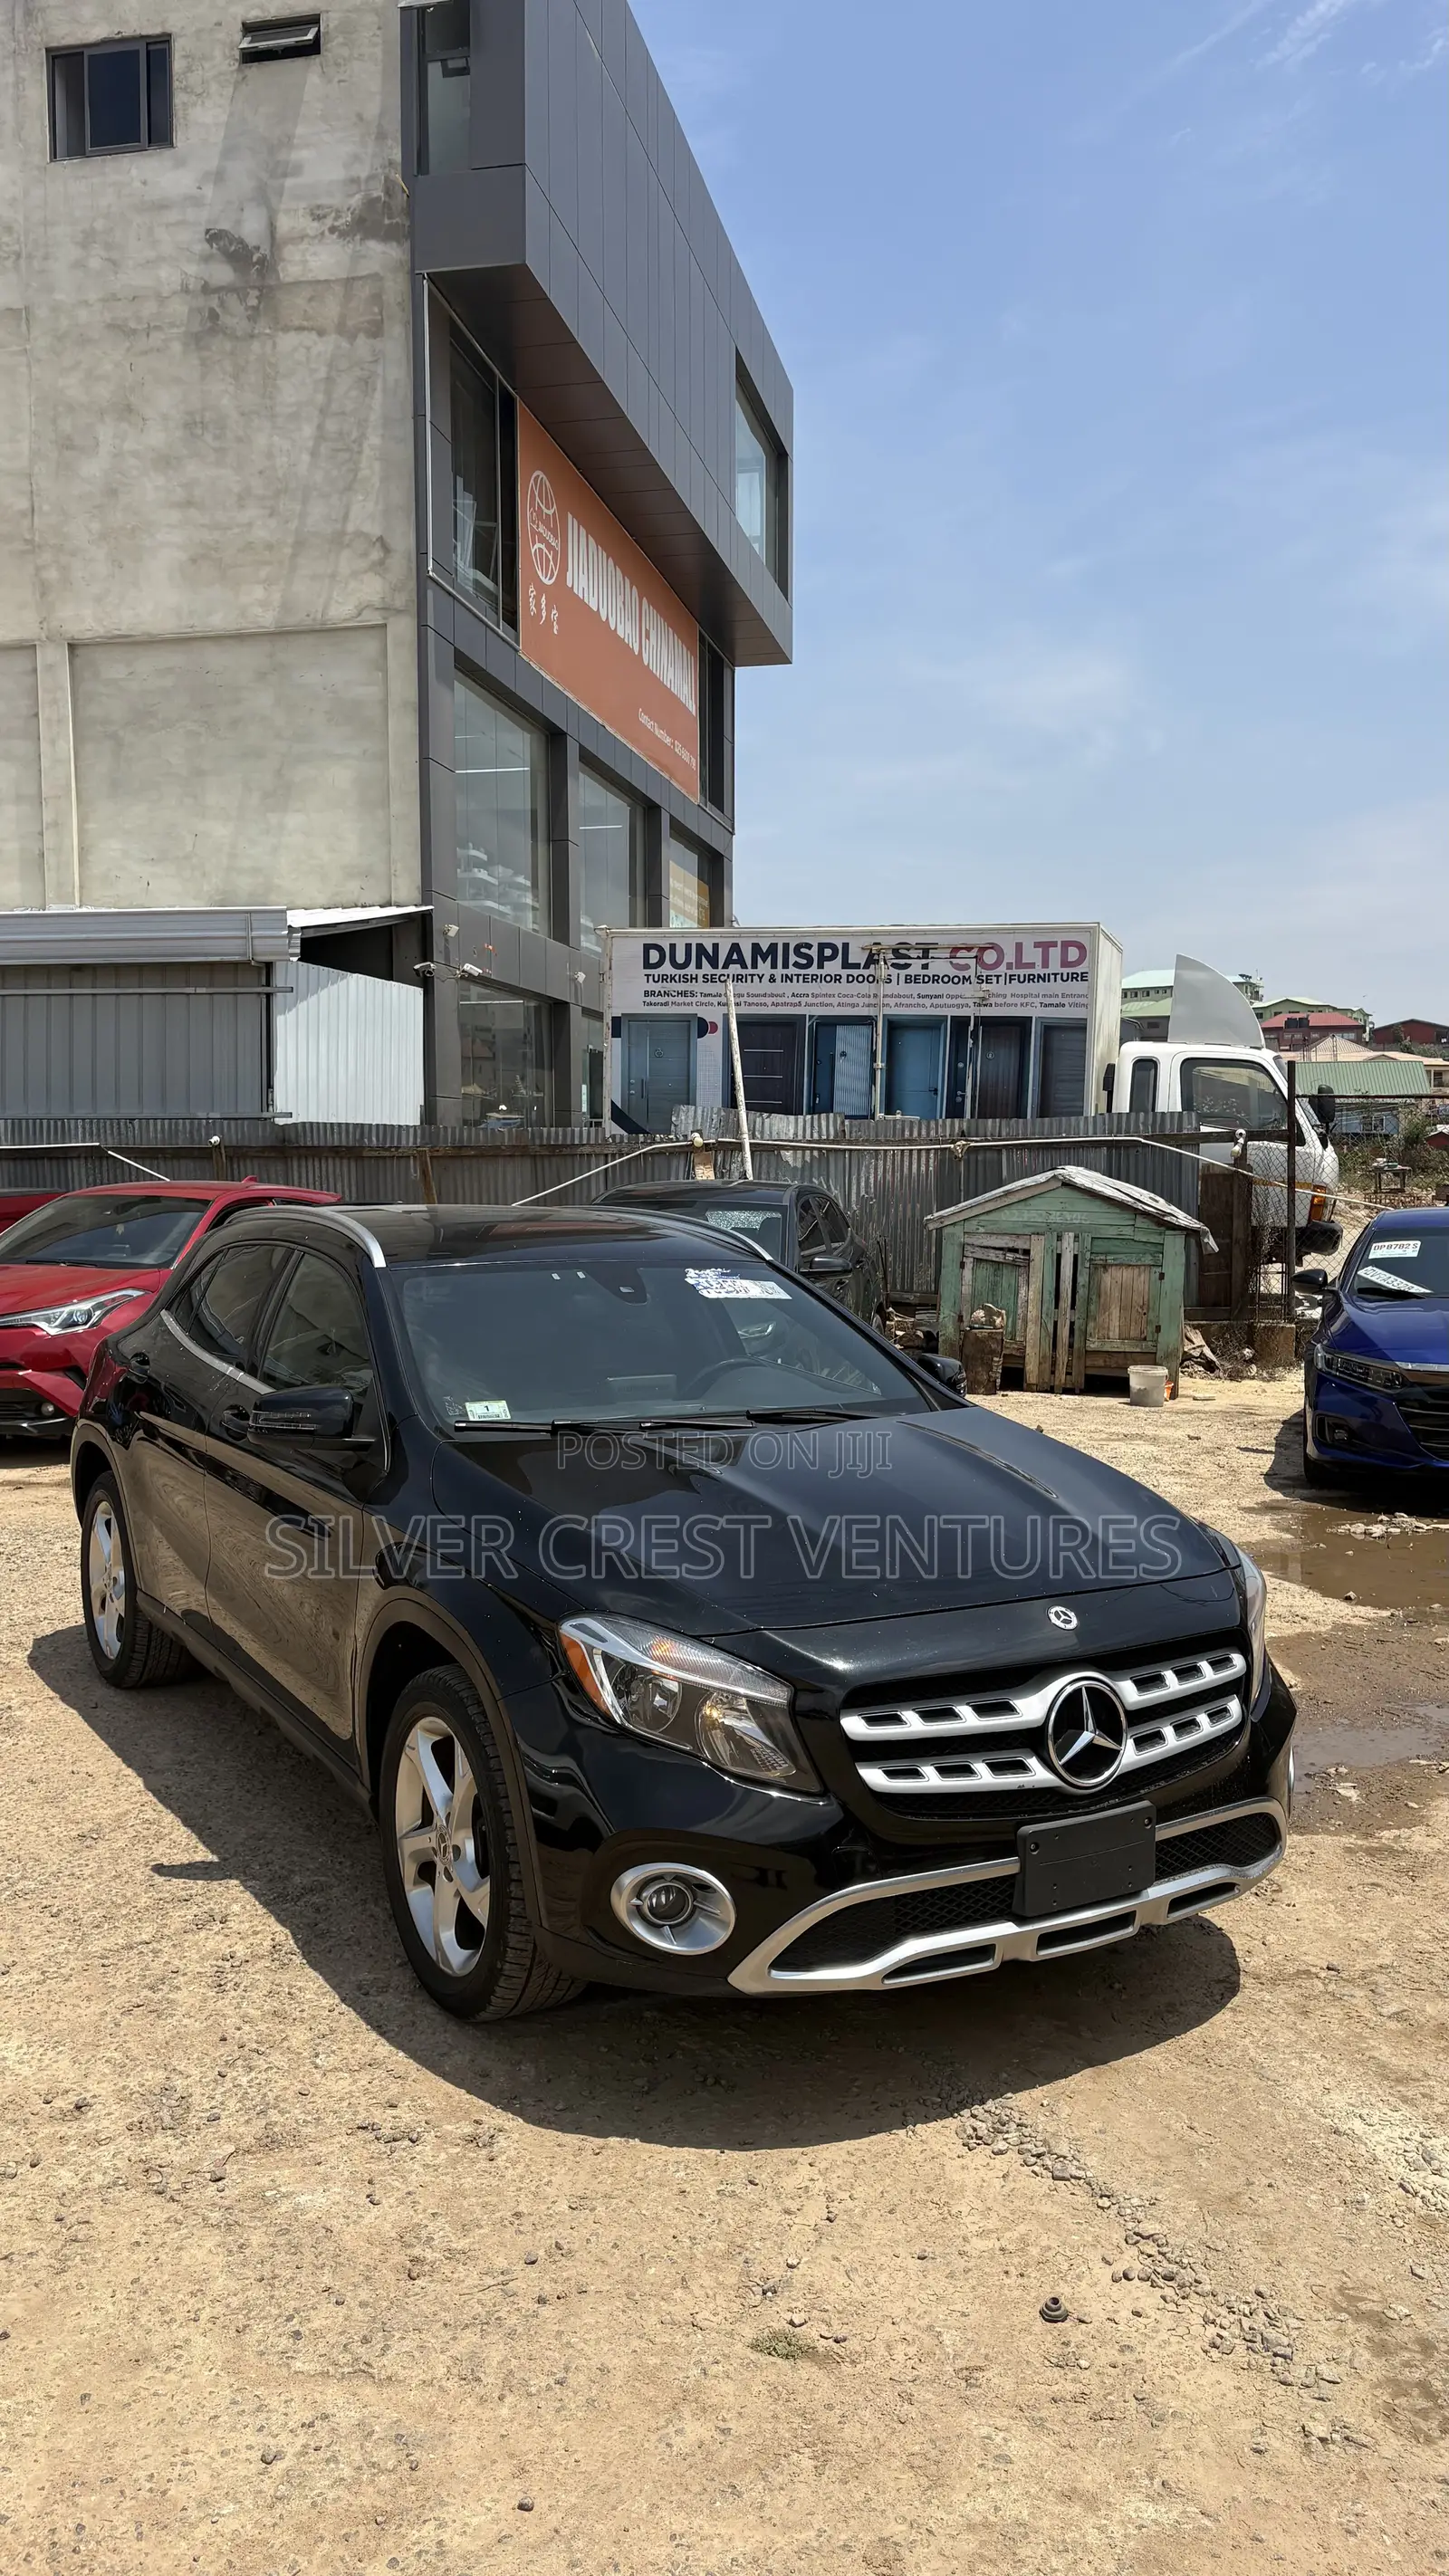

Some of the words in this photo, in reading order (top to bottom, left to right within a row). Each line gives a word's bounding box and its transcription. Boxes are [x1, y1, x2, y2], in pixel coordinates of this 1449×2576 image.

[566, 511, 639, 656] JIADUOBAO
[641, 597, 696, 717] CHINAMALL
[642, 942, 939, 971] DUNAMISPLAST
[644, 973, 698, 983] TURKISH
[702, 973, 765, 983] SECURITY
[768, 973, 777, 983] &
[781, 973, 842, 984] INTERIOR
[846, 973, 893, 984] DOOS
[904, 973, 972, 985] BEDROOM
[643, 990, 698, 998] BRANCHES:
